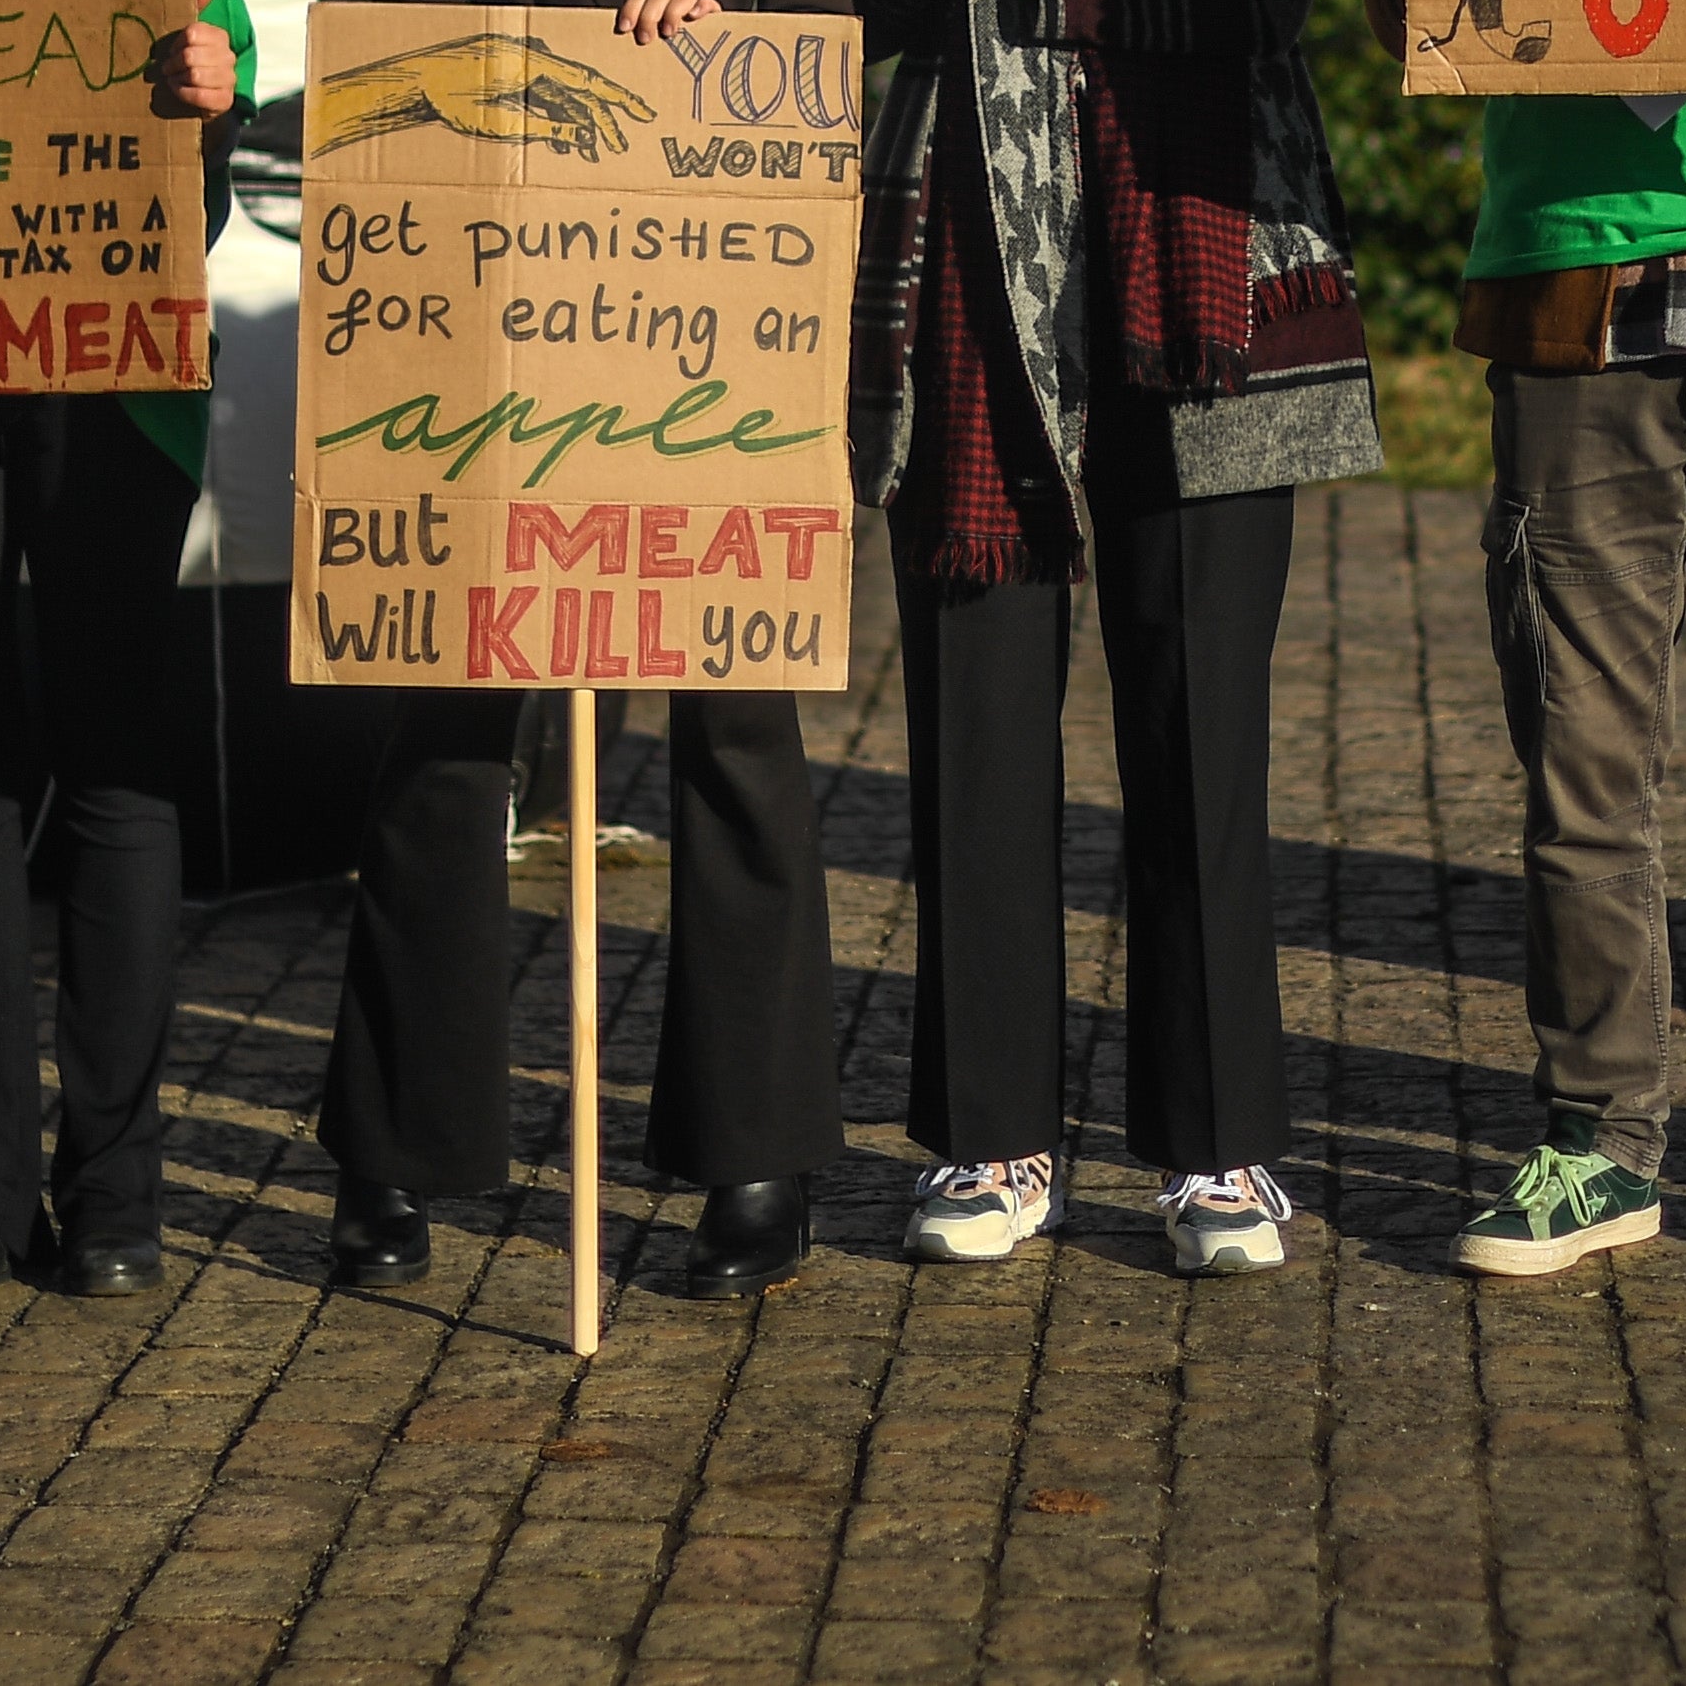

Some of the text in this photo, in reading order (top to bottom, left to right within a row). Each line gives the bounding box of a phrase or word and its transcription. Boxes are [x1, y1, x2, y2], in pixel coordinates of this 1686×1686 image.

[664, 27, 862, 132] YOU
[47, 133, 142, 177] THE
[660, 135, 860, 183] WON'T
[12, 200, 118, 239] WITH
[142, 193, 168, 230] A
[316, 200, 428, 286] get
[101, 239, 162, 277] ON
[502, 283, 719, 380] eating
[754, 310, 821, 355] an
[315, 379, 840, 488] apple
[505, 501, 844, 580] MEAT
[466, 586, 687, 681] KILL
[701, 602, 822, 679] you
